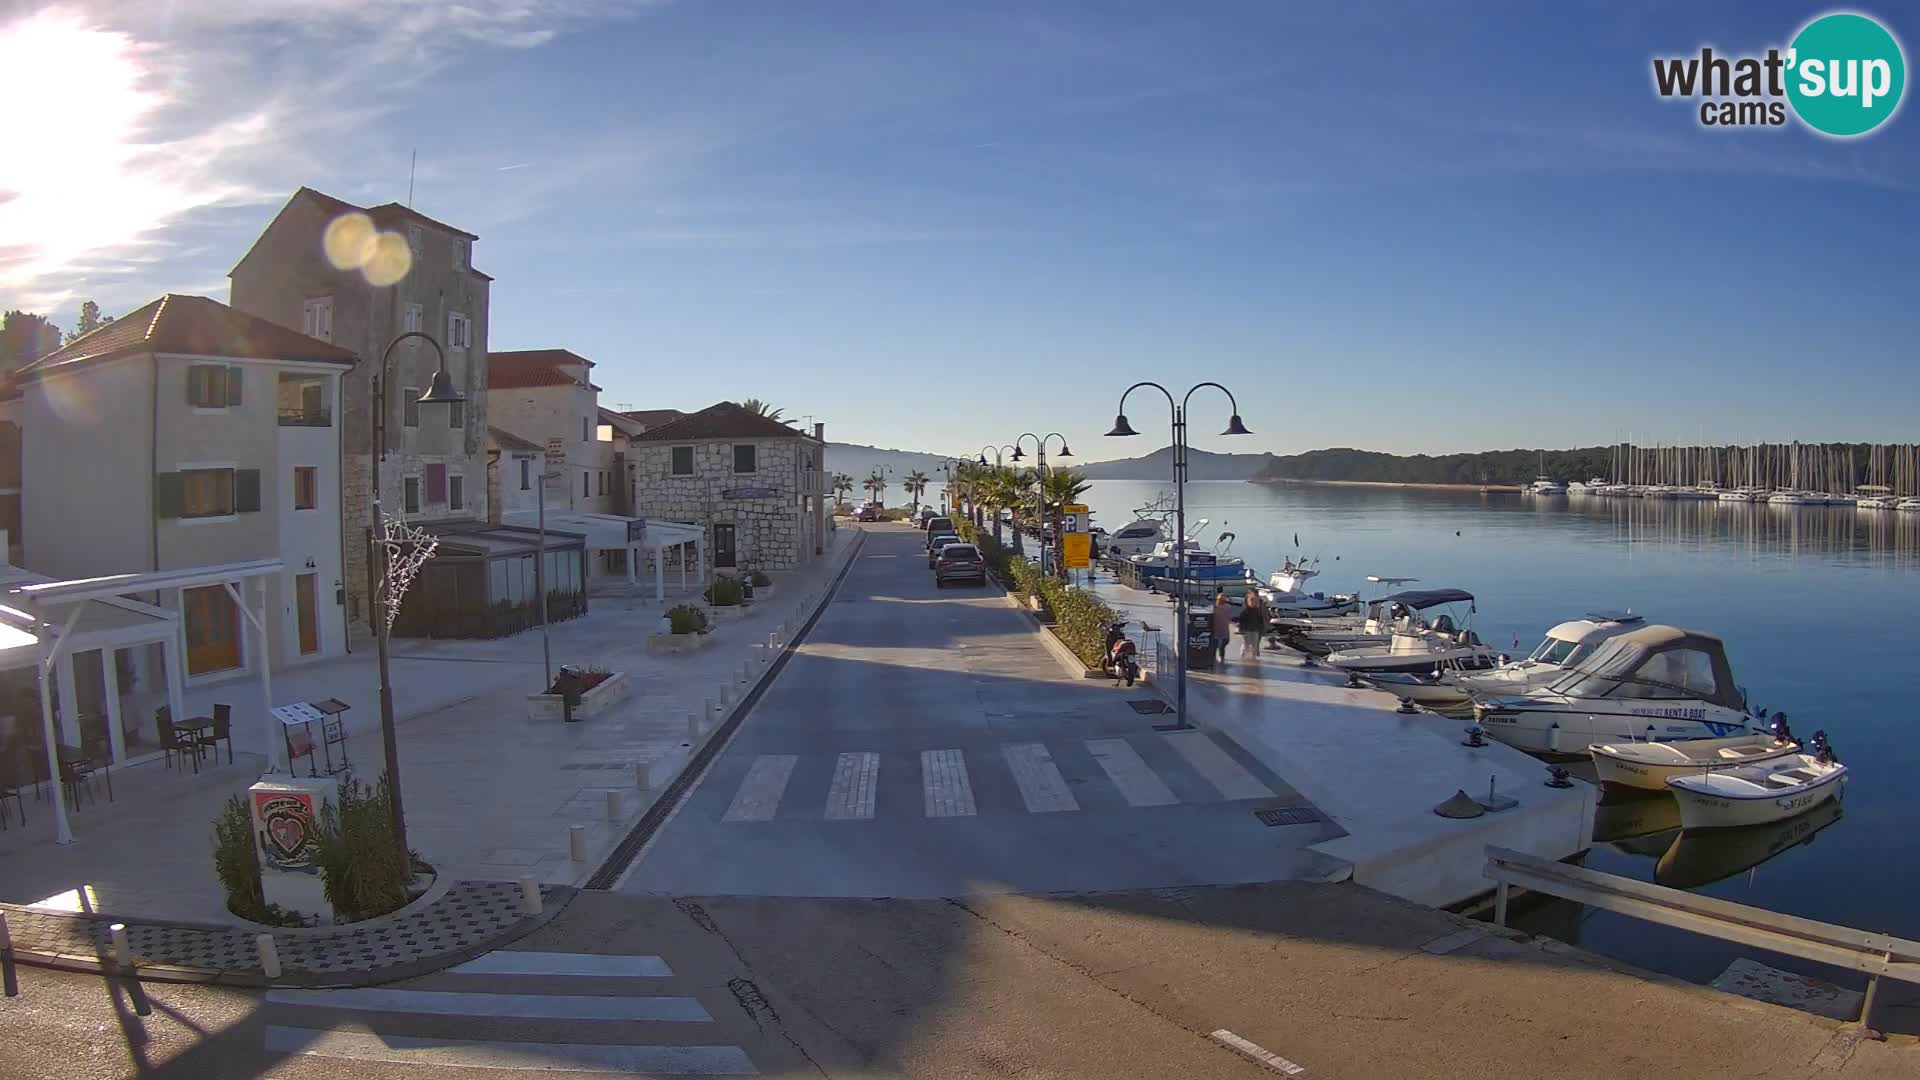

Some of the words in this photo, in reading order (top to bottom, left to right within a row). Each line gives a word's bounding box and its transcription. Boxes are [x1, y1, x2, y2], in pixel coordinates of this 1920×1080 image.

[1664, 707, 1683, 718] RENT
[1683, 708, 1689, 719] A
[1689, 708, 1707, 720] BOAT
